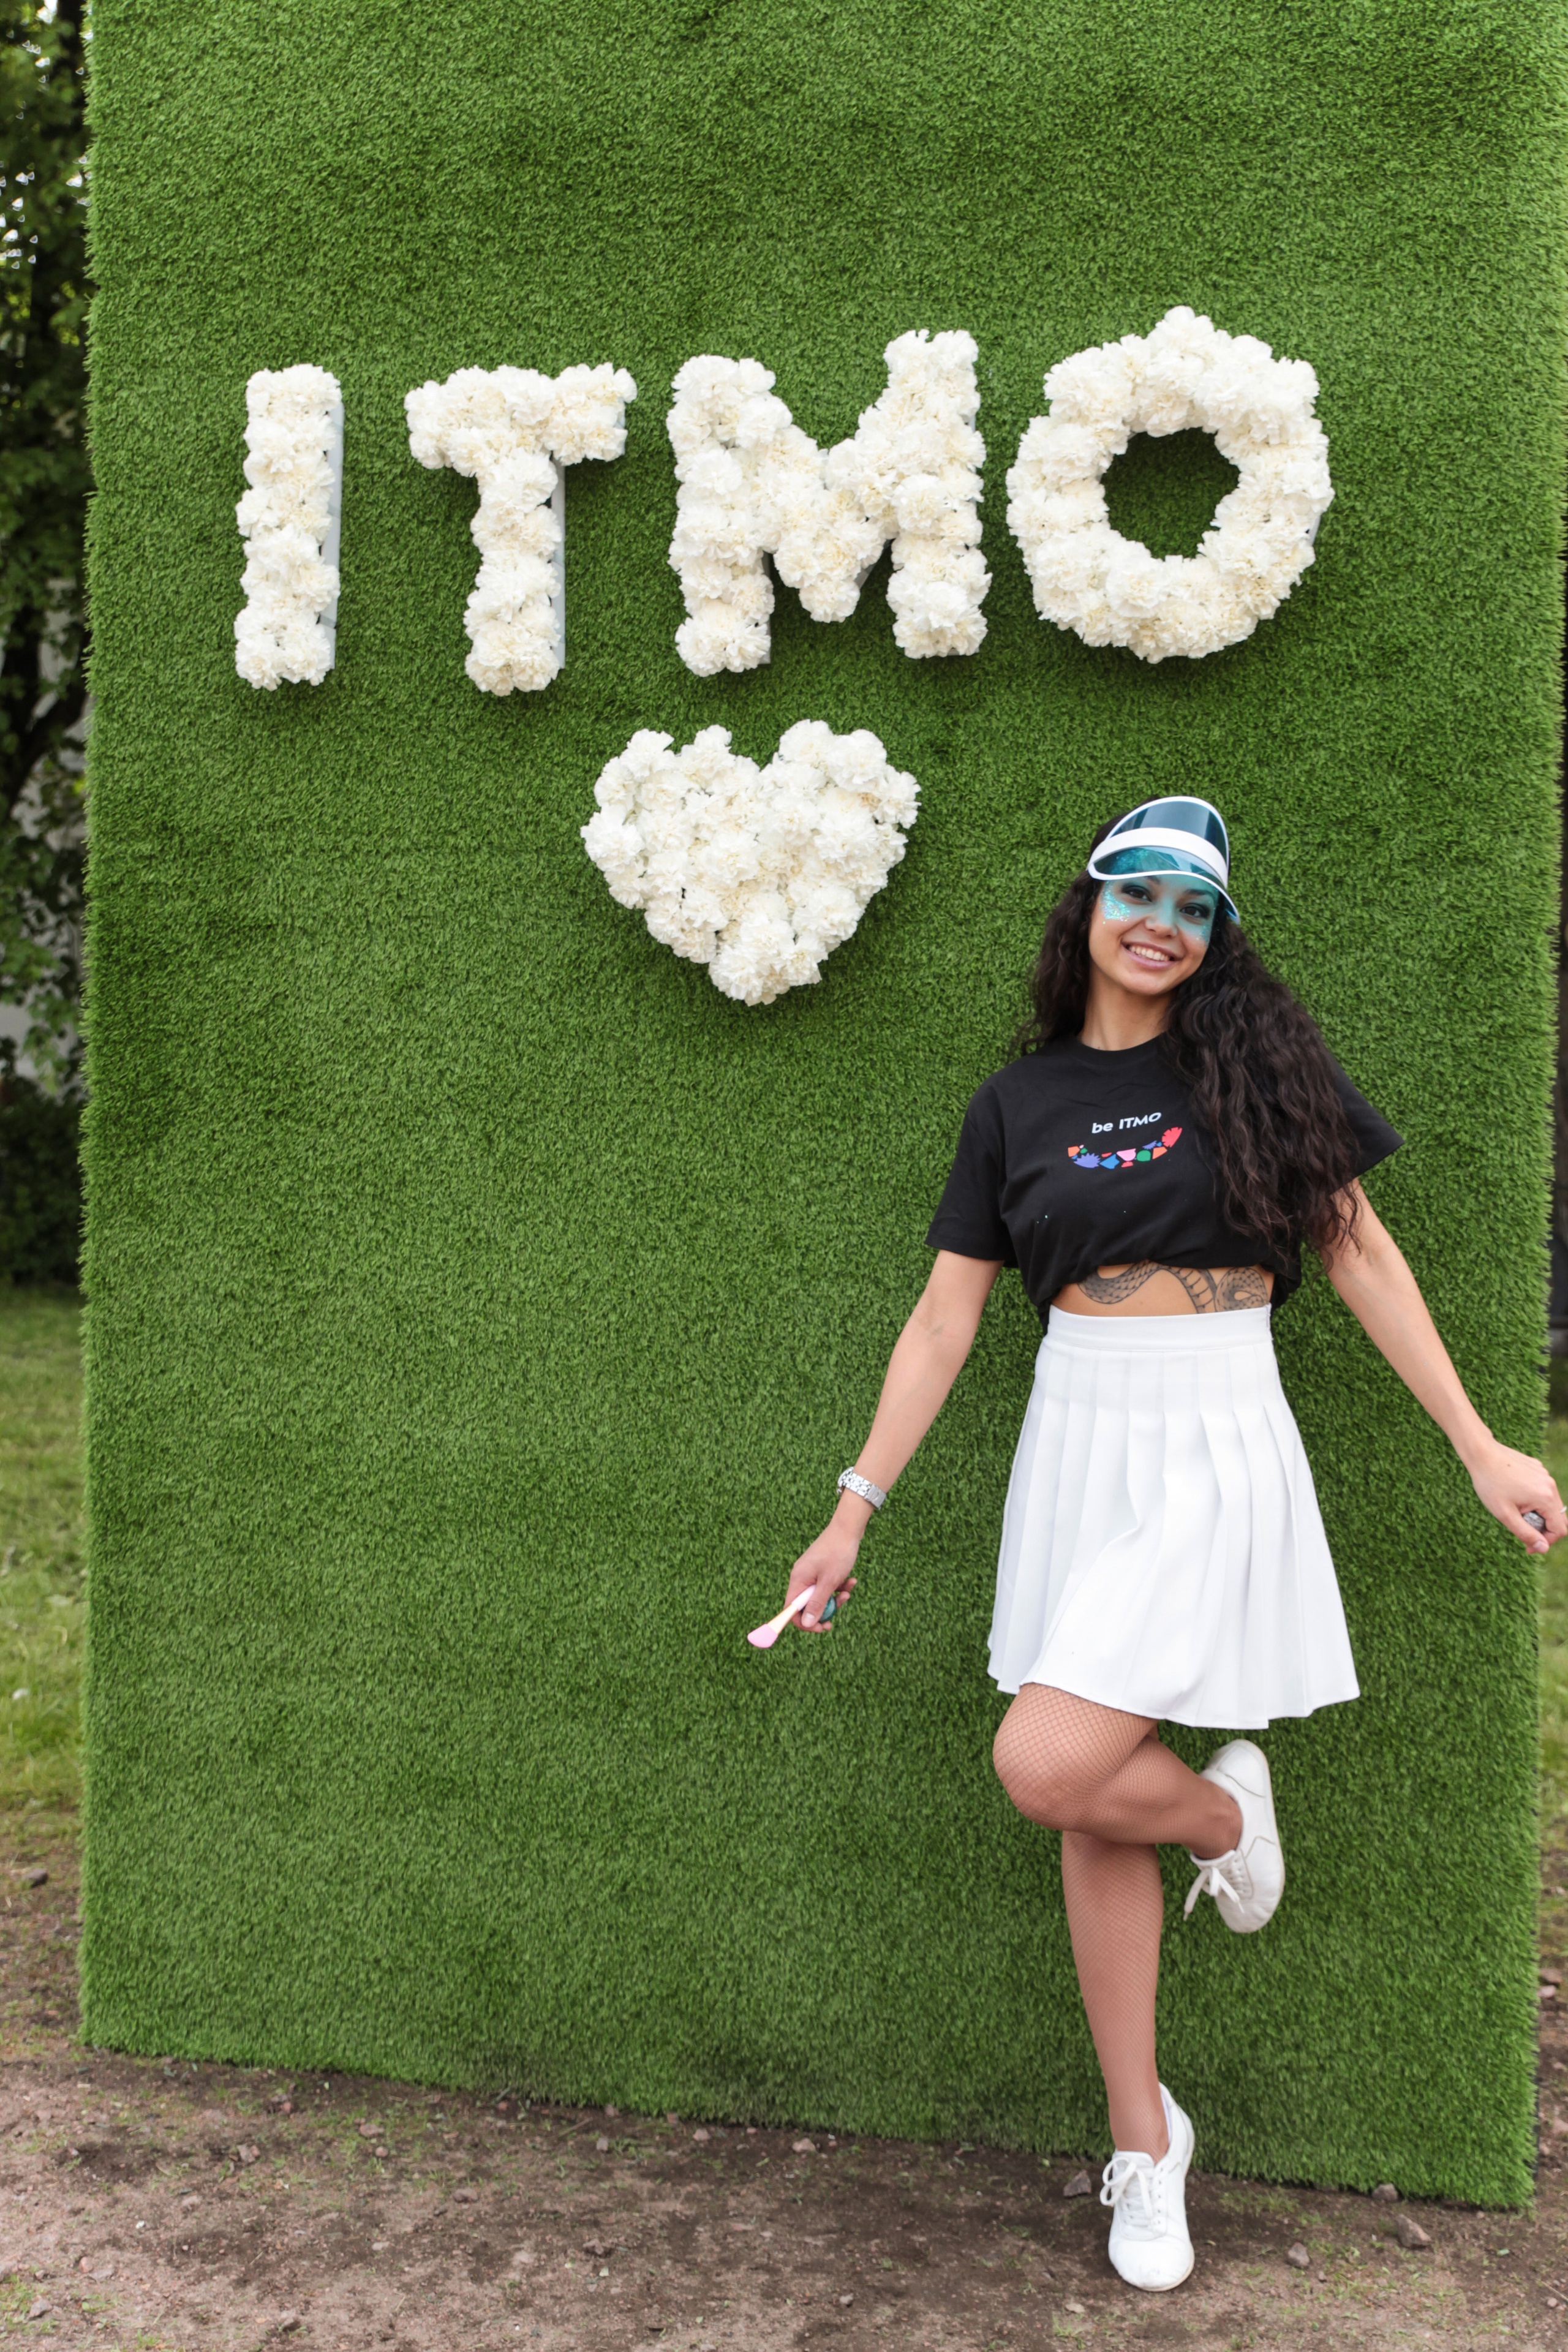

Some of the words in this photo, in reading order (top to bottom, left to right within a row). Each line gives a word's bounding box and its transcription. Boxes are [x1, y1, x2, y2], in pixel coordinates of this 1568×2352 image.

[233, 306, 1335, 695] ITMO
[1091, 1123, 1113, 1133] be
[1119, 1112, 1161, 1129] ITMO
